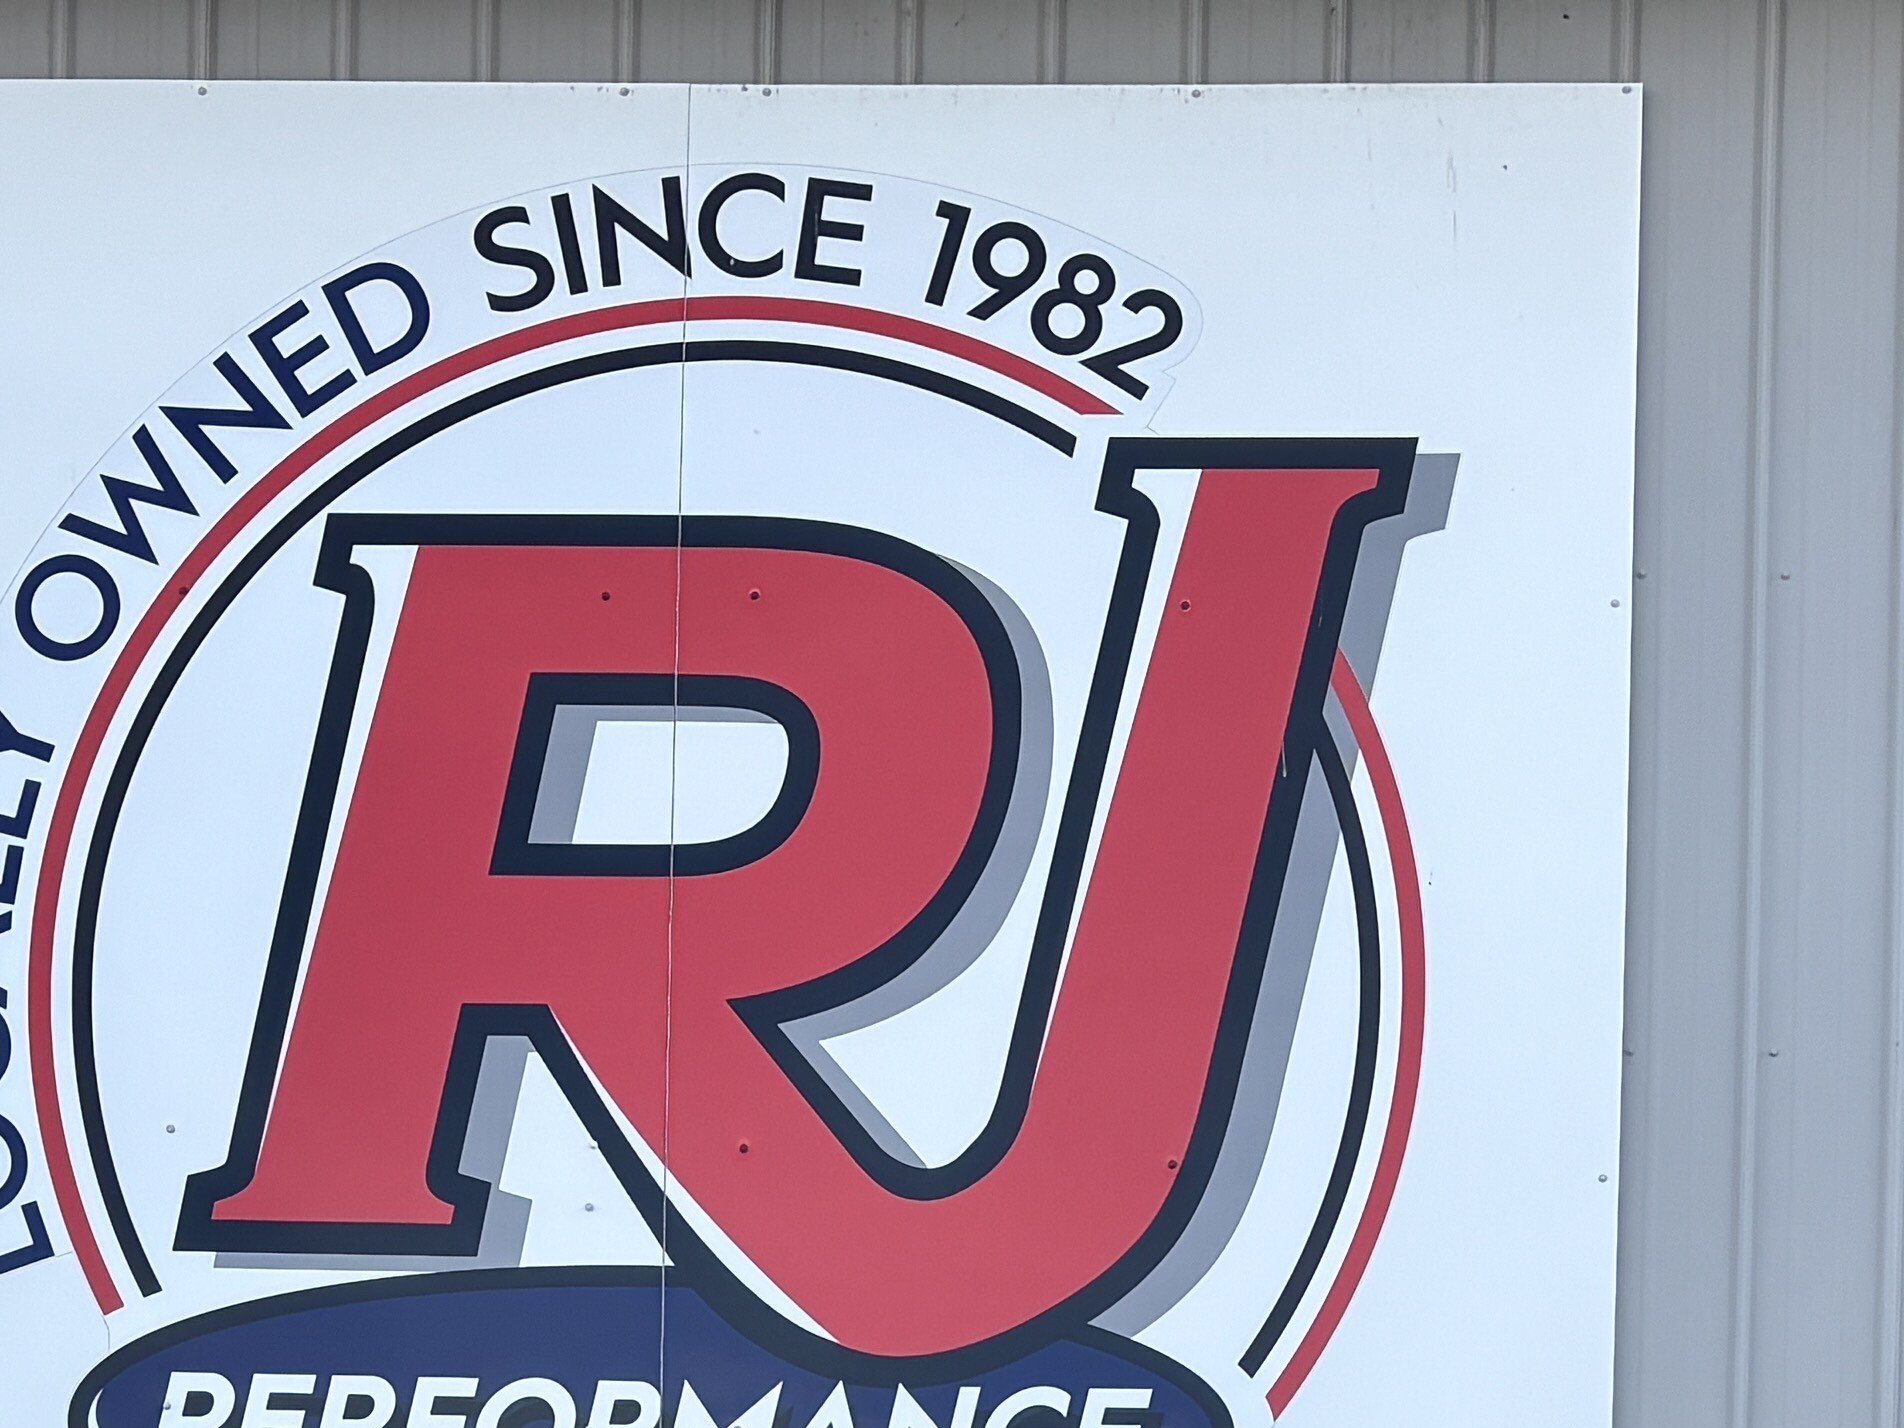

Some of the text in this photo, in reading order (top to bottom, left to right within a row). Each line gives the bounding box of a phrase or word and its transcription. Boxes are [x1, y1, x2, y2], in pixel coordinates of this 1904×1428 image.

[13, 261, 432, 662] OWNED
[472, 173, 875, 313] SINCE
[923, 199, 1184, 401] 1982
[173, 437, 1418, 1378] RJ
